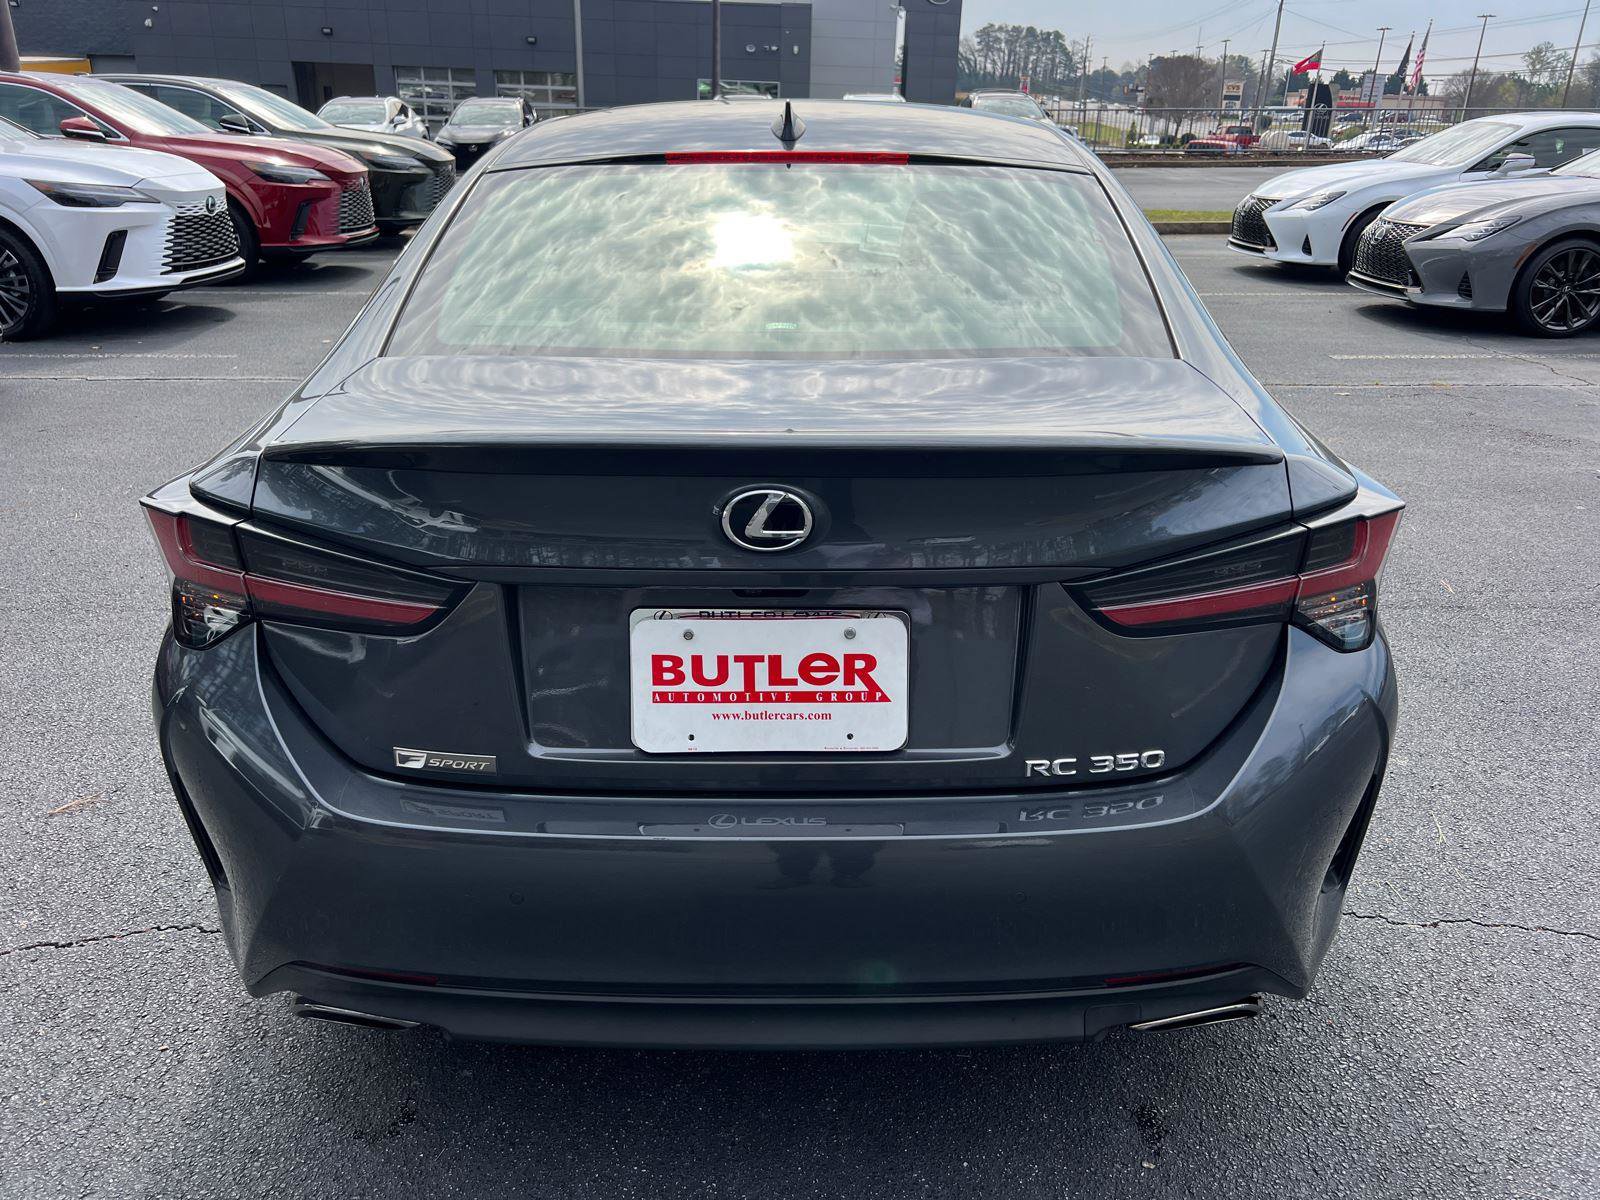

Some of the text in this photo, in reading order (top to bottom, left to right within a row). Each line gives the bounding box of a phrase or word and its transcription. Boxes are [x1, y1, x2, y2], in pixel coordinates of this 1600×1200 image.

[654, 691, 882, 702] AUTOMOTIVE GROUP
[712, 710, 832, 720] www.butlercars.com
[427, 758, 491, 770] SPORT
[1024, 749, 1166, 777] RC 350
[741, 817, 827, 826] LEXUS
